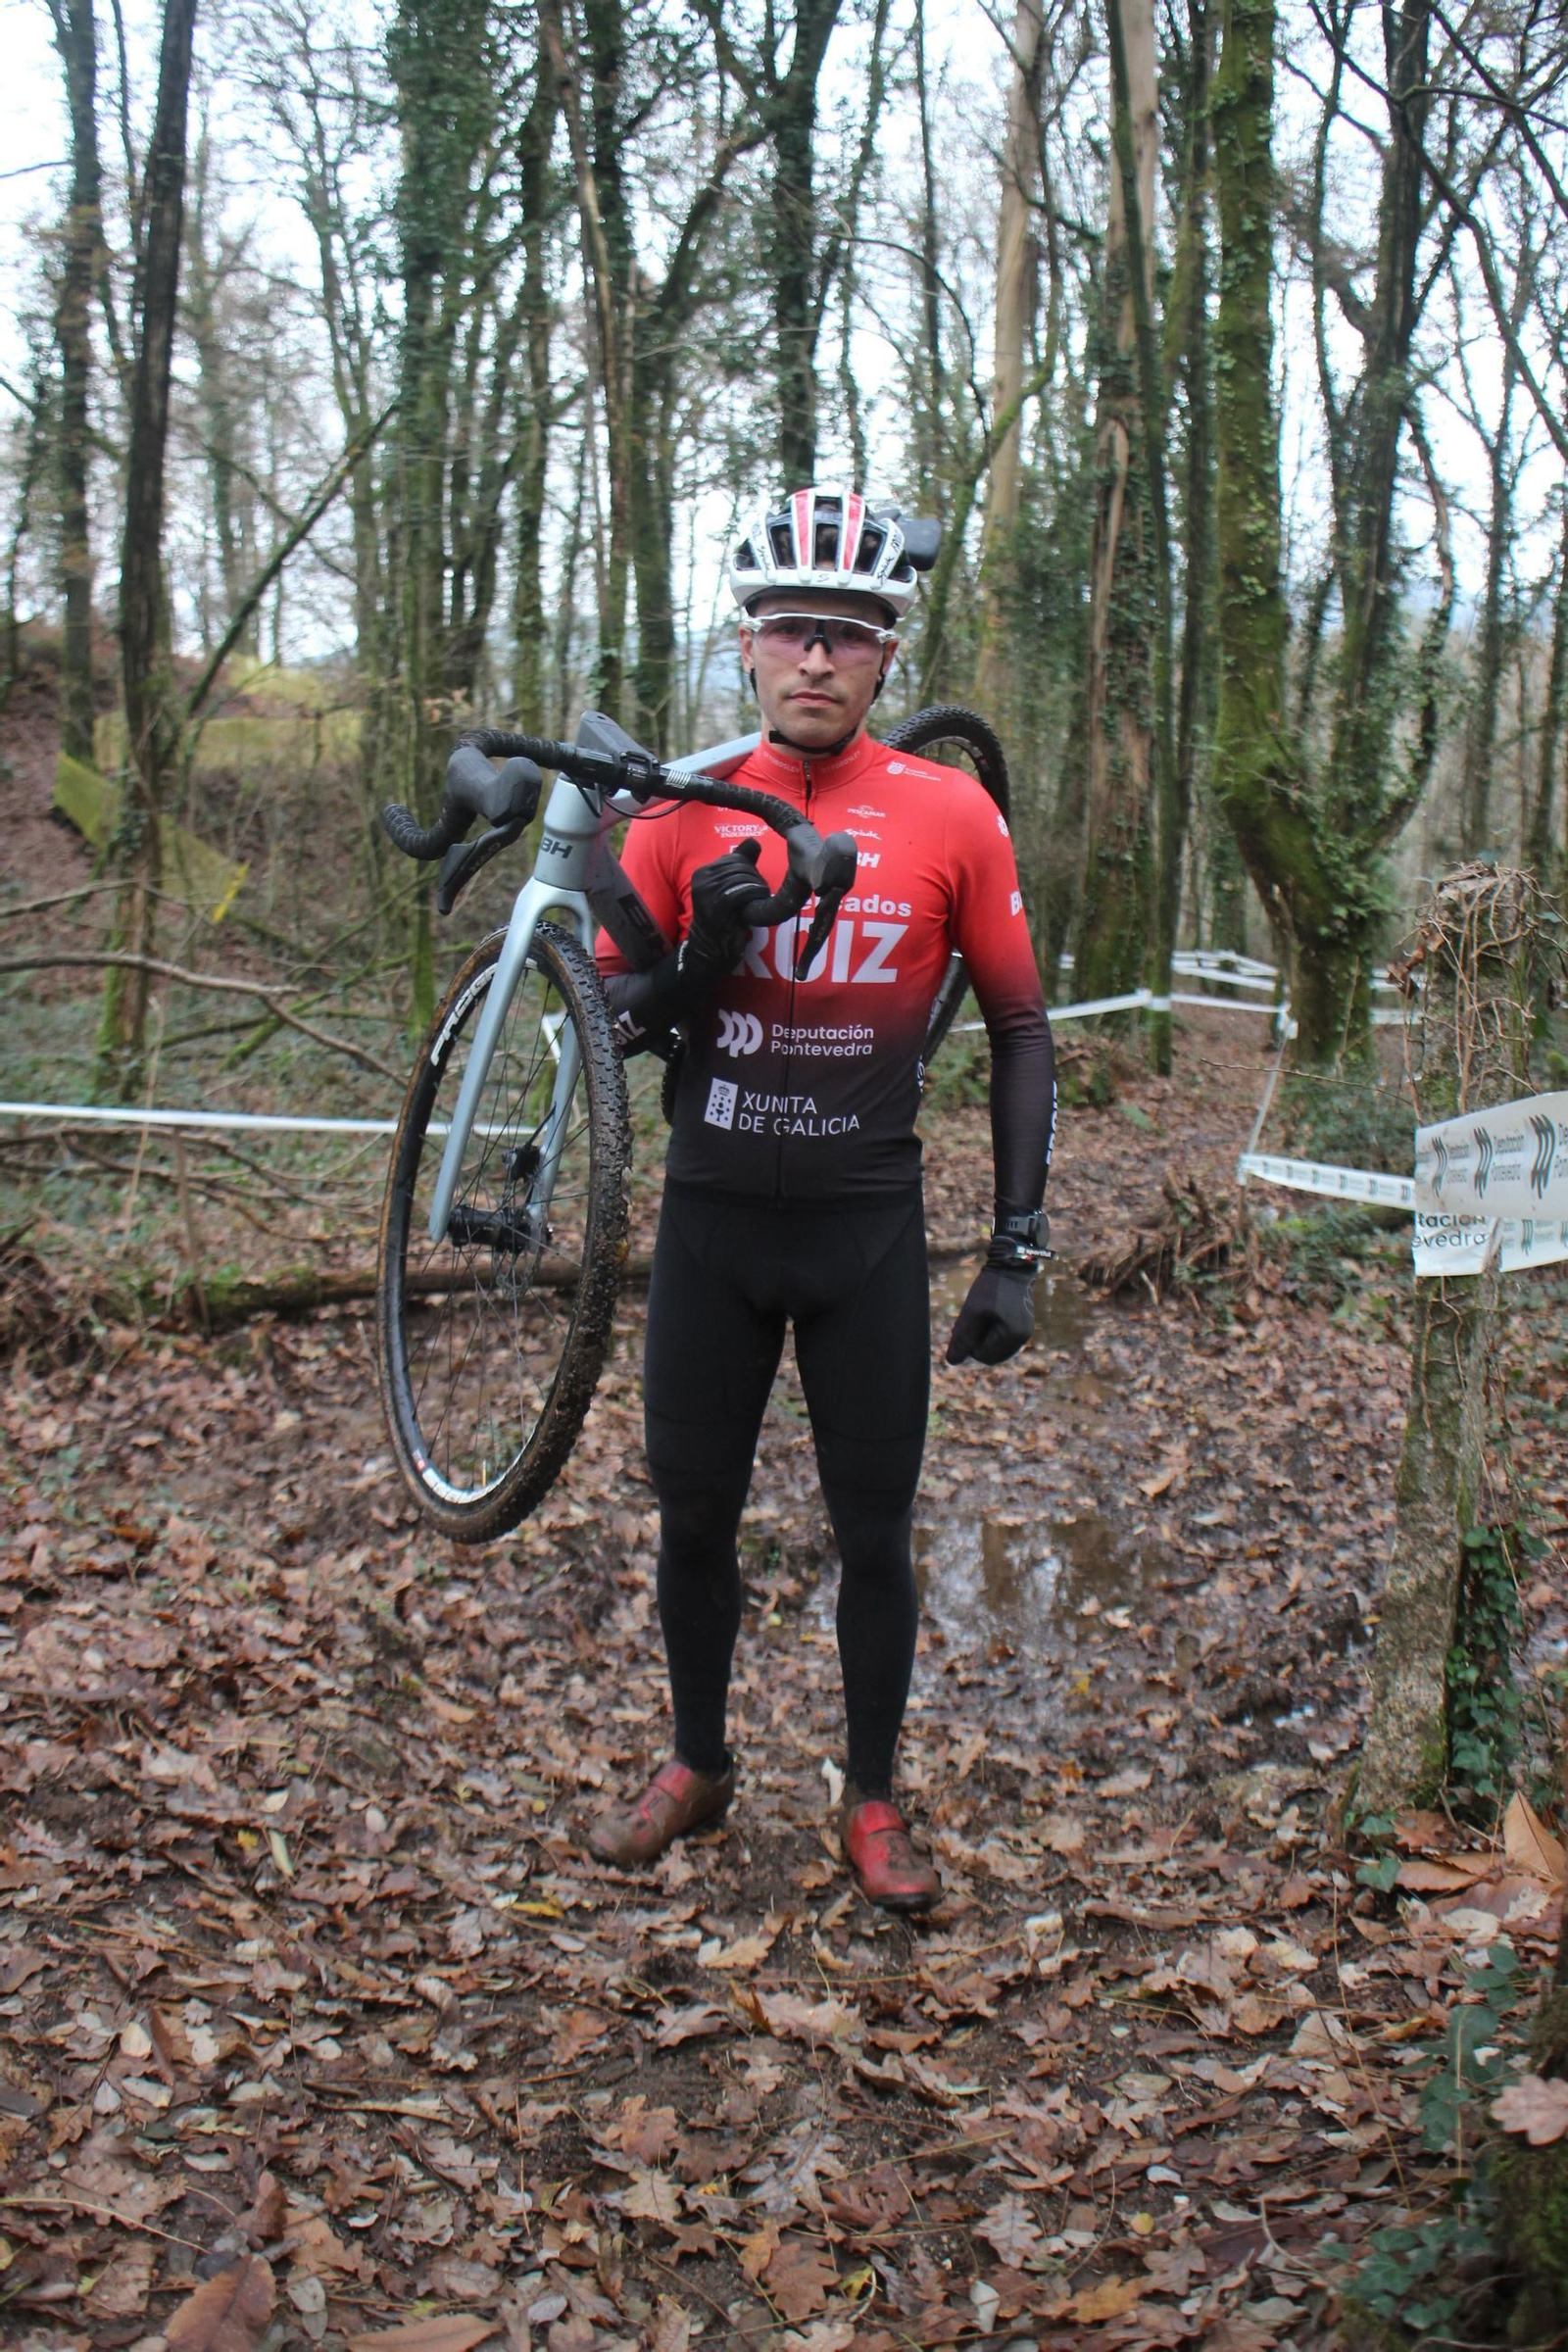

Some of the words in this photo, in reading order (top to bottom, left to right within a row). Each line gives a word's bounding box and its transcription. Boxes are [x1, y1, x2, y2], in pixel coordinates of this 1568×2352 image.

[714, 824, 760, 833] VICTORY
[541, 837, 573, 858] BH
[772, 1024, 874, 1043] Deputación
[771, 1040, 873, 1056] Pontevedra
[738, 1113, 765, 1134] DE
[773, 1114, 860, 1136] GALICIA
